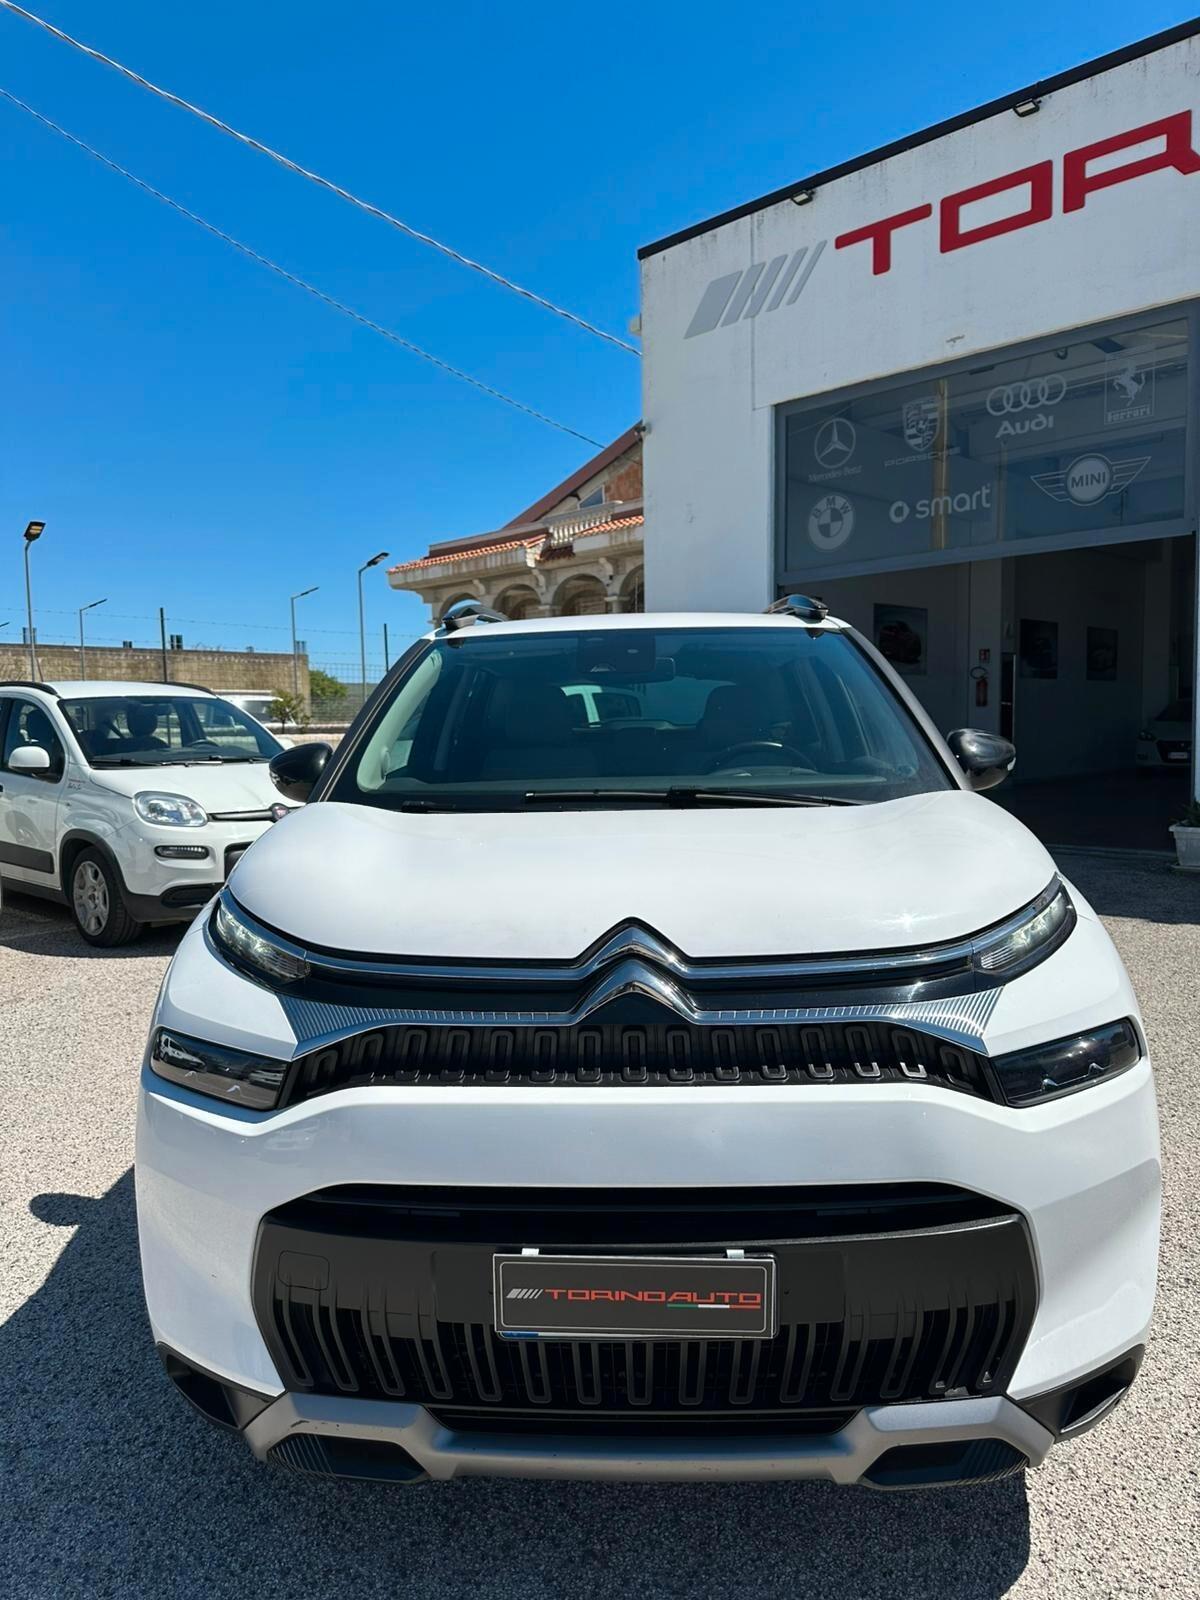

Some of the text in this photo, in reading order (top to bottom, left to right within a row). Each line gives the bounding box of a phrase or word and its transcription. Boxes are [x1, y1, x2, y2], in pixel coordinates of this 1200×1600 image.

[995, 413, 1055, 438] Audi
[1071, 471, 1107, 488] MINI
[915, 483, 991, 519] smart
[545, 1289, 761, 1304] TORINOAUTO
